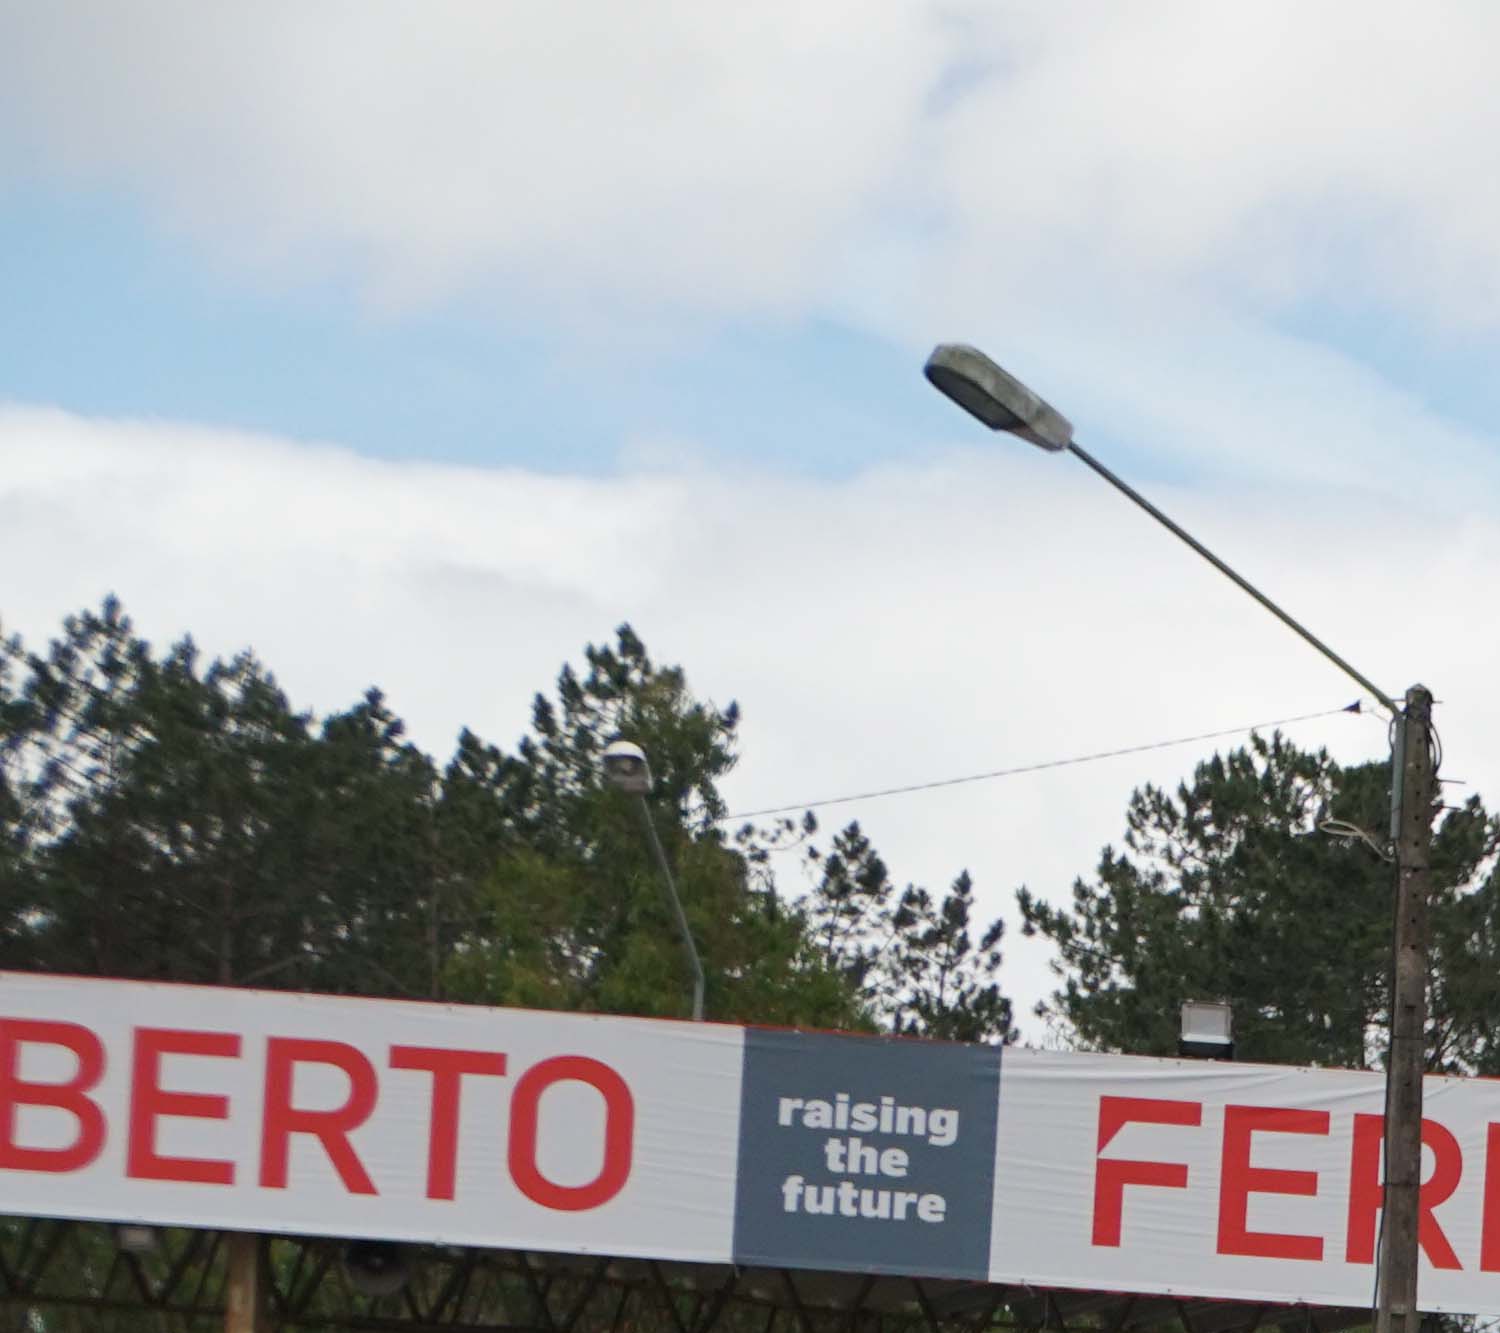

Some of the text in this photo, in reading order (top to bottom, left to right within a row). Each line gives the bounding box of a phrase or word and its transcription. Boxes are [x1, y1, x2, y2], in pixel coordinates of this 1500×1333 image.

[0, 1016, 634, 1211] BERTO
[778, 1092, 959, 1146] raising
[824, 1137, 909, 1177] the
[782, 1174, 946, 1222] future
